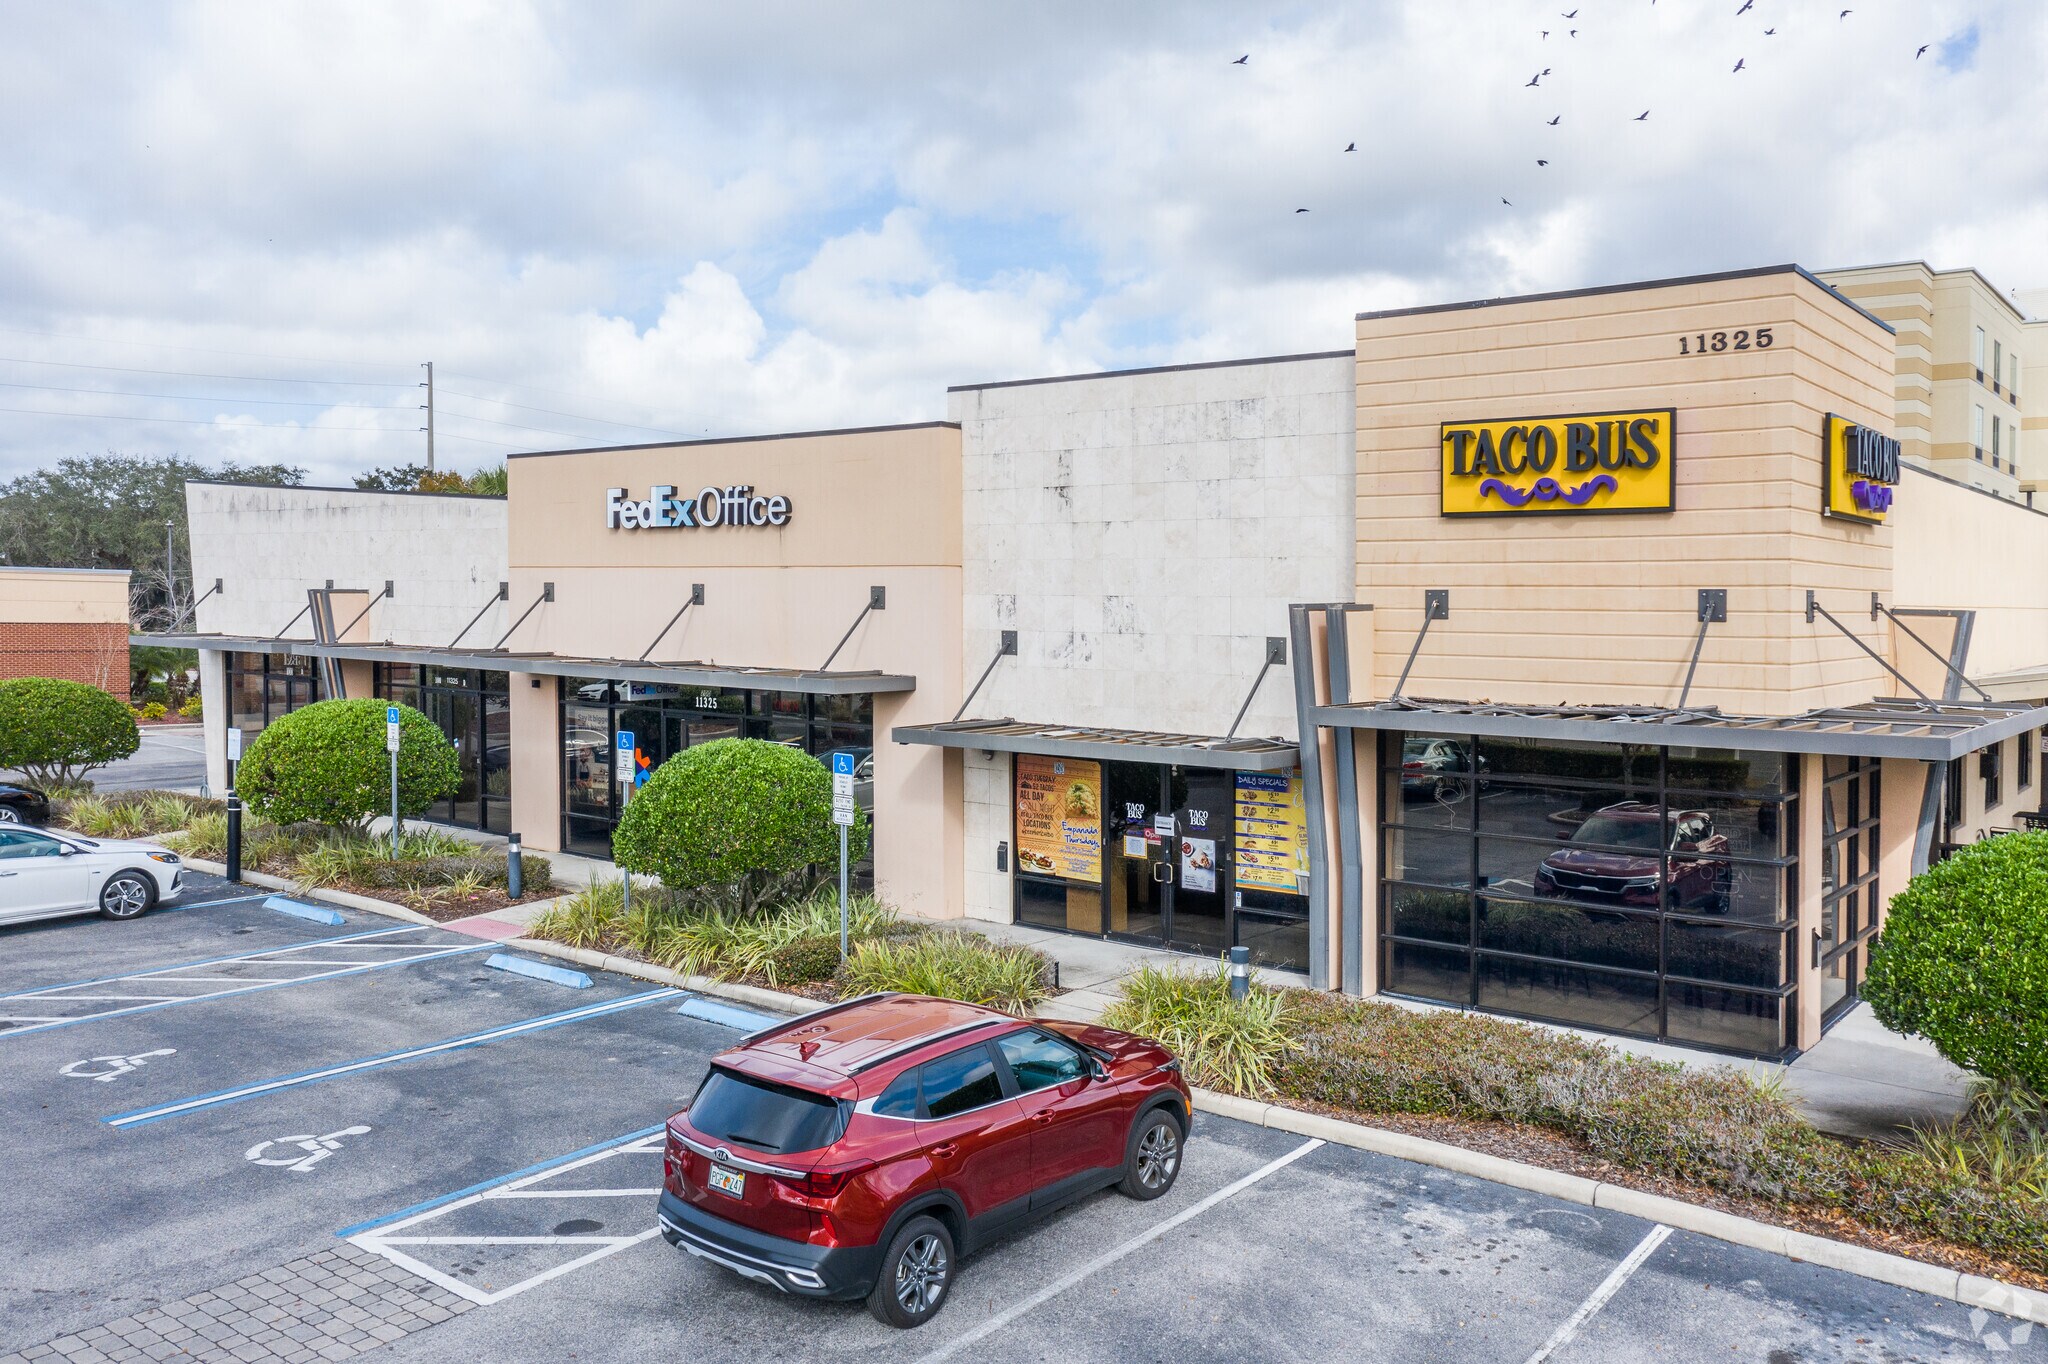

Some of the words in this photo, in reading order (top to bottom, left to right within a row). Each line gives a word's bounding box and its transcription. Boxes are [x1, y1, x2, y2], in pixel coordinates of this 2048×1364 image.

[1679, 328, 1774, 355] 11325
[1443, 424, 1558, 477] TACO
[1563, 418, 1661, 473] BUS
[1852, 425, 1883, 479] TACO
[1883, 436, 1901, 485] BUS
[606, 485, 696, 529] FedEx
[696, 485, 793, 528] Office
[656, 684, 678, 694] Office
[695, 696, 718, 709] 11325
[1237, 776, 1256, 786] DAILY
[1257, 777, 1288, 787] SPECIALS
[1020, 790, 1031, 800] ALL
[1032, 791, 1045, 801] DAY
[1126, 802, 1145, 812] TACO
[1127, 810, 1143, 819] BUS
[1188, 809, 1208, 819] TACO
[1023, 819, 1051, 830] LOCATIONS
[1190, 817, 1206, 827] BUS
[1062, 821, 1098, 835] Empanada
[1064, 834, 1100, 850] Thursdays
[1700, 865, 1752, 884] OPEN
[715, 1150, 728, 1160] KIA
